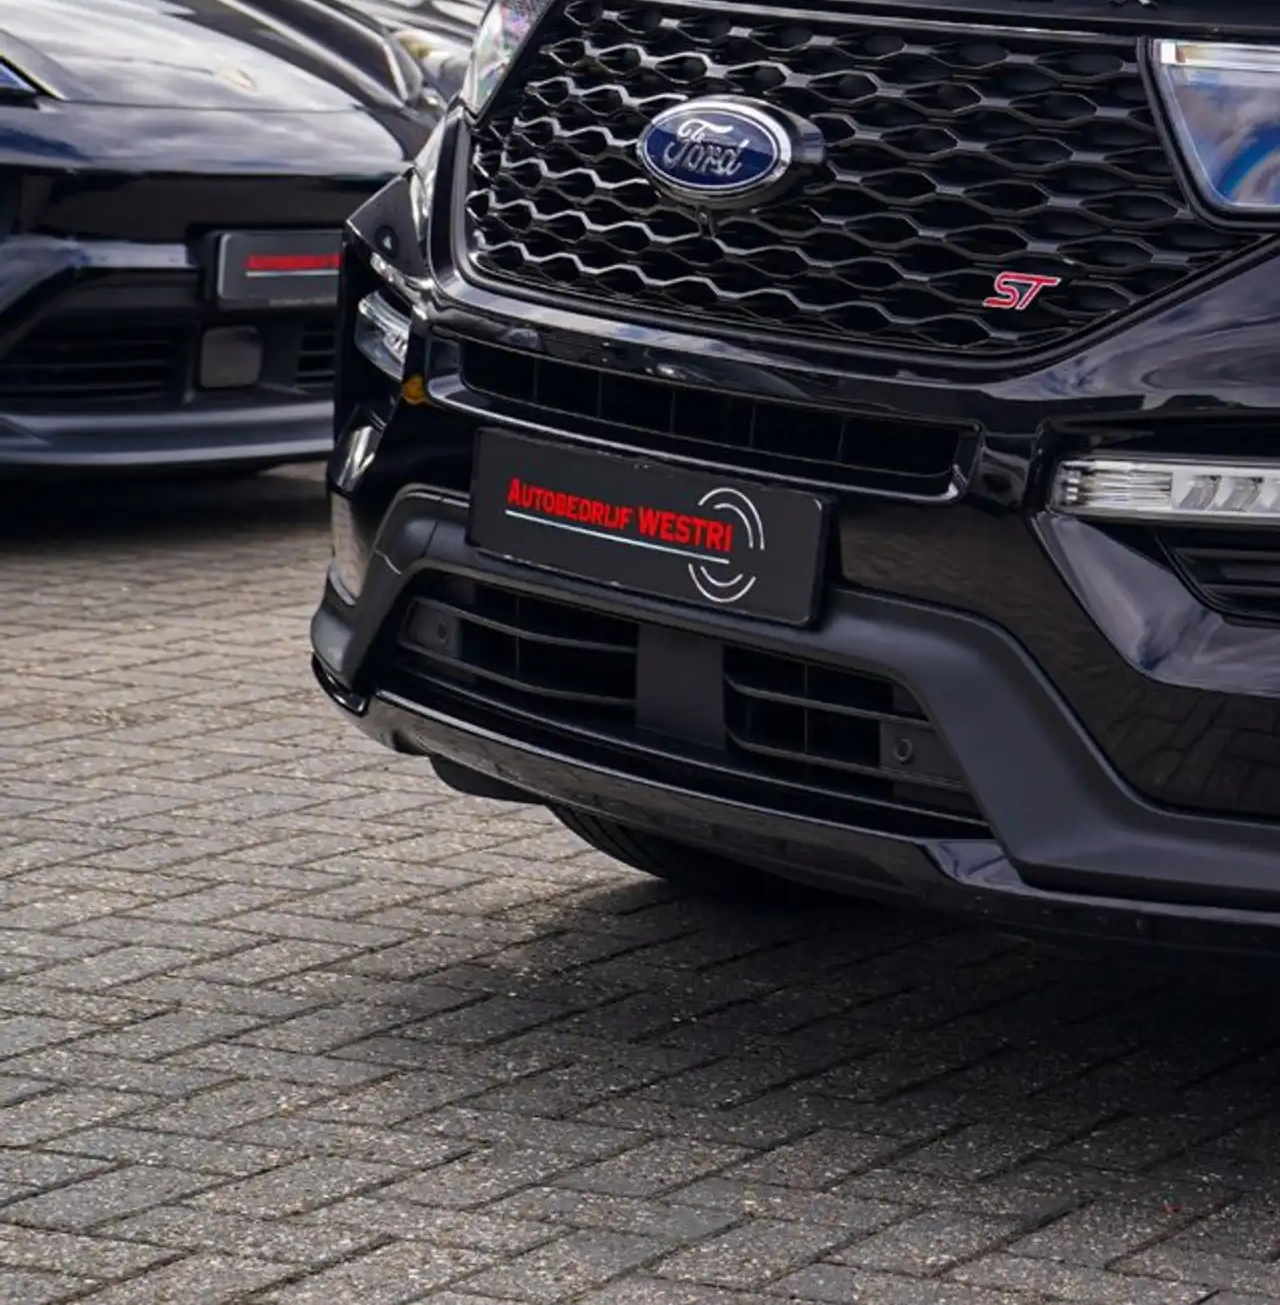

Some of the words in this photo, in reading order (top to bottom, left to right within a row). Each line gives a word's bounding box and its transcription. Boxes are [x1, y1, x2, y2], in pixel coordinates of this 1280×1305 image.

[662, 118, 751, 176] Ford
[982, 271, 1062, 310] ST
[507, 477, 633, 531] AUTOBEDRIJF
[636, 506, 733, 552] WESTRI
